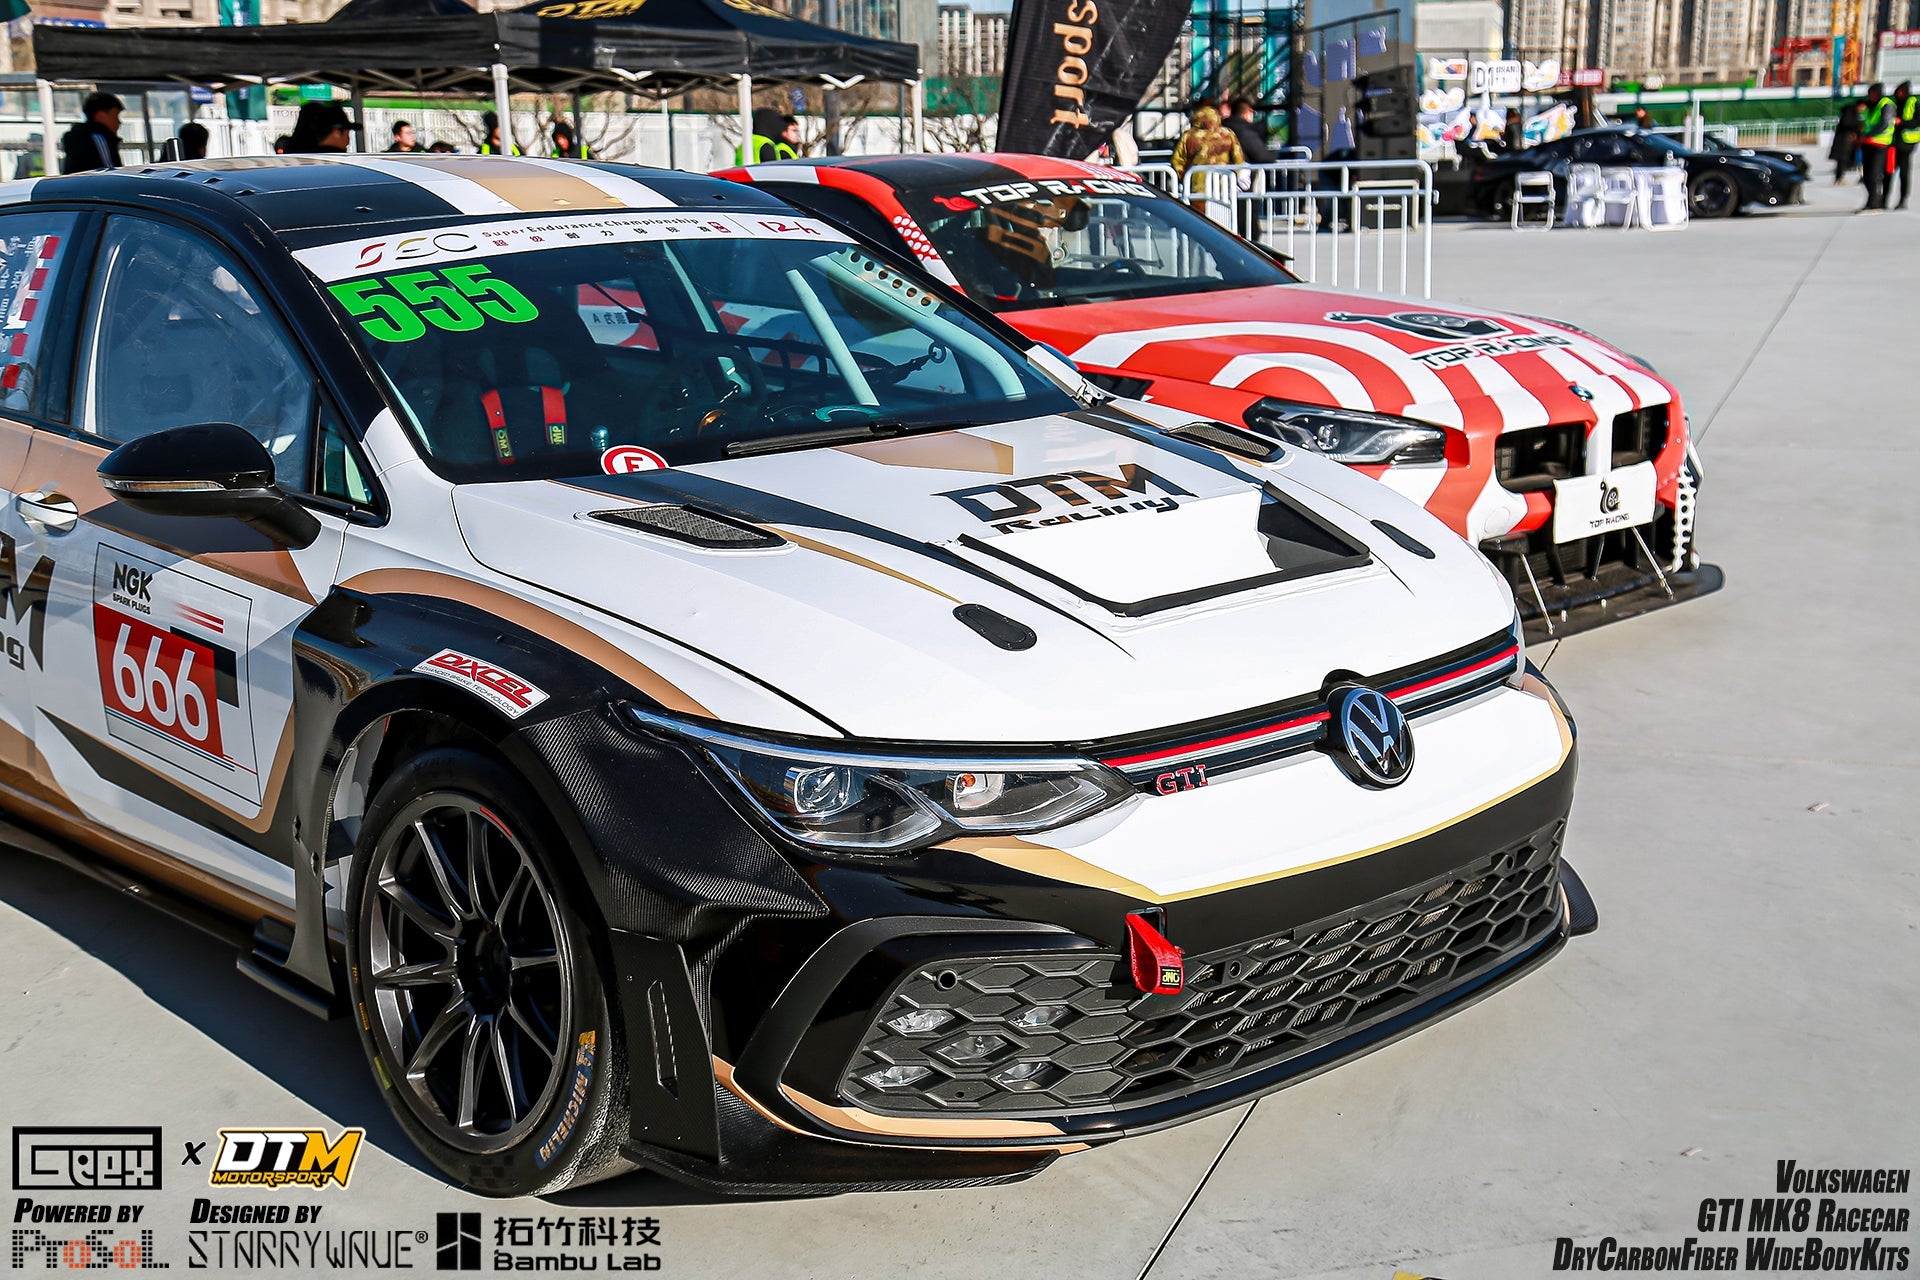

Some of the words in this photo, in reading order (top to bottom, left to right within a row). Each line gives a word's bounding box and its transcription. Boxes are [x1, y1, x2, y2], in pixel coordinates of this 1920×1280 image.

[961, 181, 1039, 204] TOP
[1039, 180, 1157, 199] RACING
[482, 229, 525, 238] Super
[526, 222, 603, 233] Endurance
[604, 217, 699, 227] Championship
[326, 263, 540, 343] 555
[1411, 345, 1474, 367] TOP
[1474, 334, 1573, 355] RACING
[930, 463, 1200, 522] DTM
[112, 561, 153, 603] NGK
[112, 592, 131, 607] SPARK
[131, 600, 151, 615] PLUGS
[112, 622, 209, 742] 666
[430, 652, 533, 707] DIXCEL
[472, 682, 519, 714] TECHNOLOGY
[1156, 763, 1209, 796] GTI
[538, 1069, 590, 1163] MICHELIN
